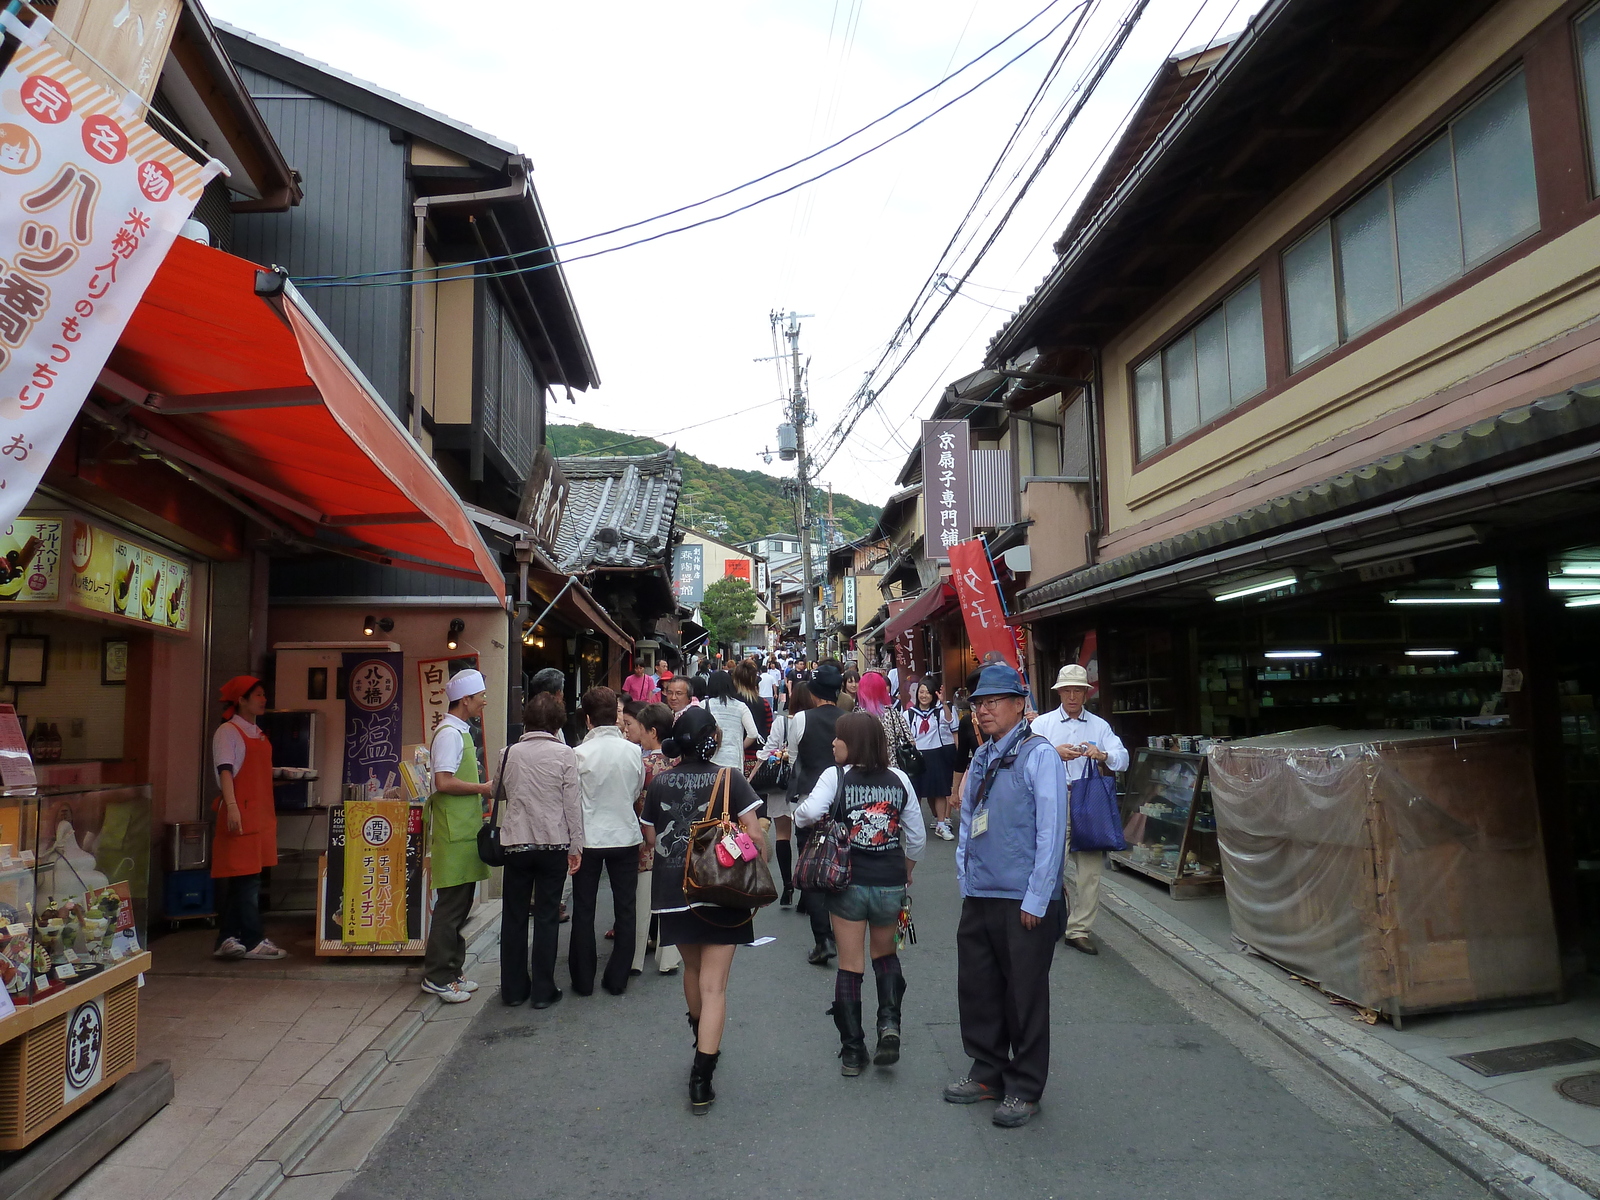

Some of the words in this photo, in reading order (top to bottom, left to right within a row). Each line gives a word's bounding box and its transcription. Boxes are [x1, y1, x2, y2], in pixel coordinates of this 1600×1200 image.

[938, 431, 959, 547] 京扇子専門舗
[46, 523, 60, 573] ブルーベリー
[346, 713, 399, 766] 塩
[845, 785, 903, 812] ELLEGARDEN
[371, 820, 384, 842] 西尾
[361, 855, 375, 928] チョコイチゴ
[377, 855, 392, 928] チョコバナナ
